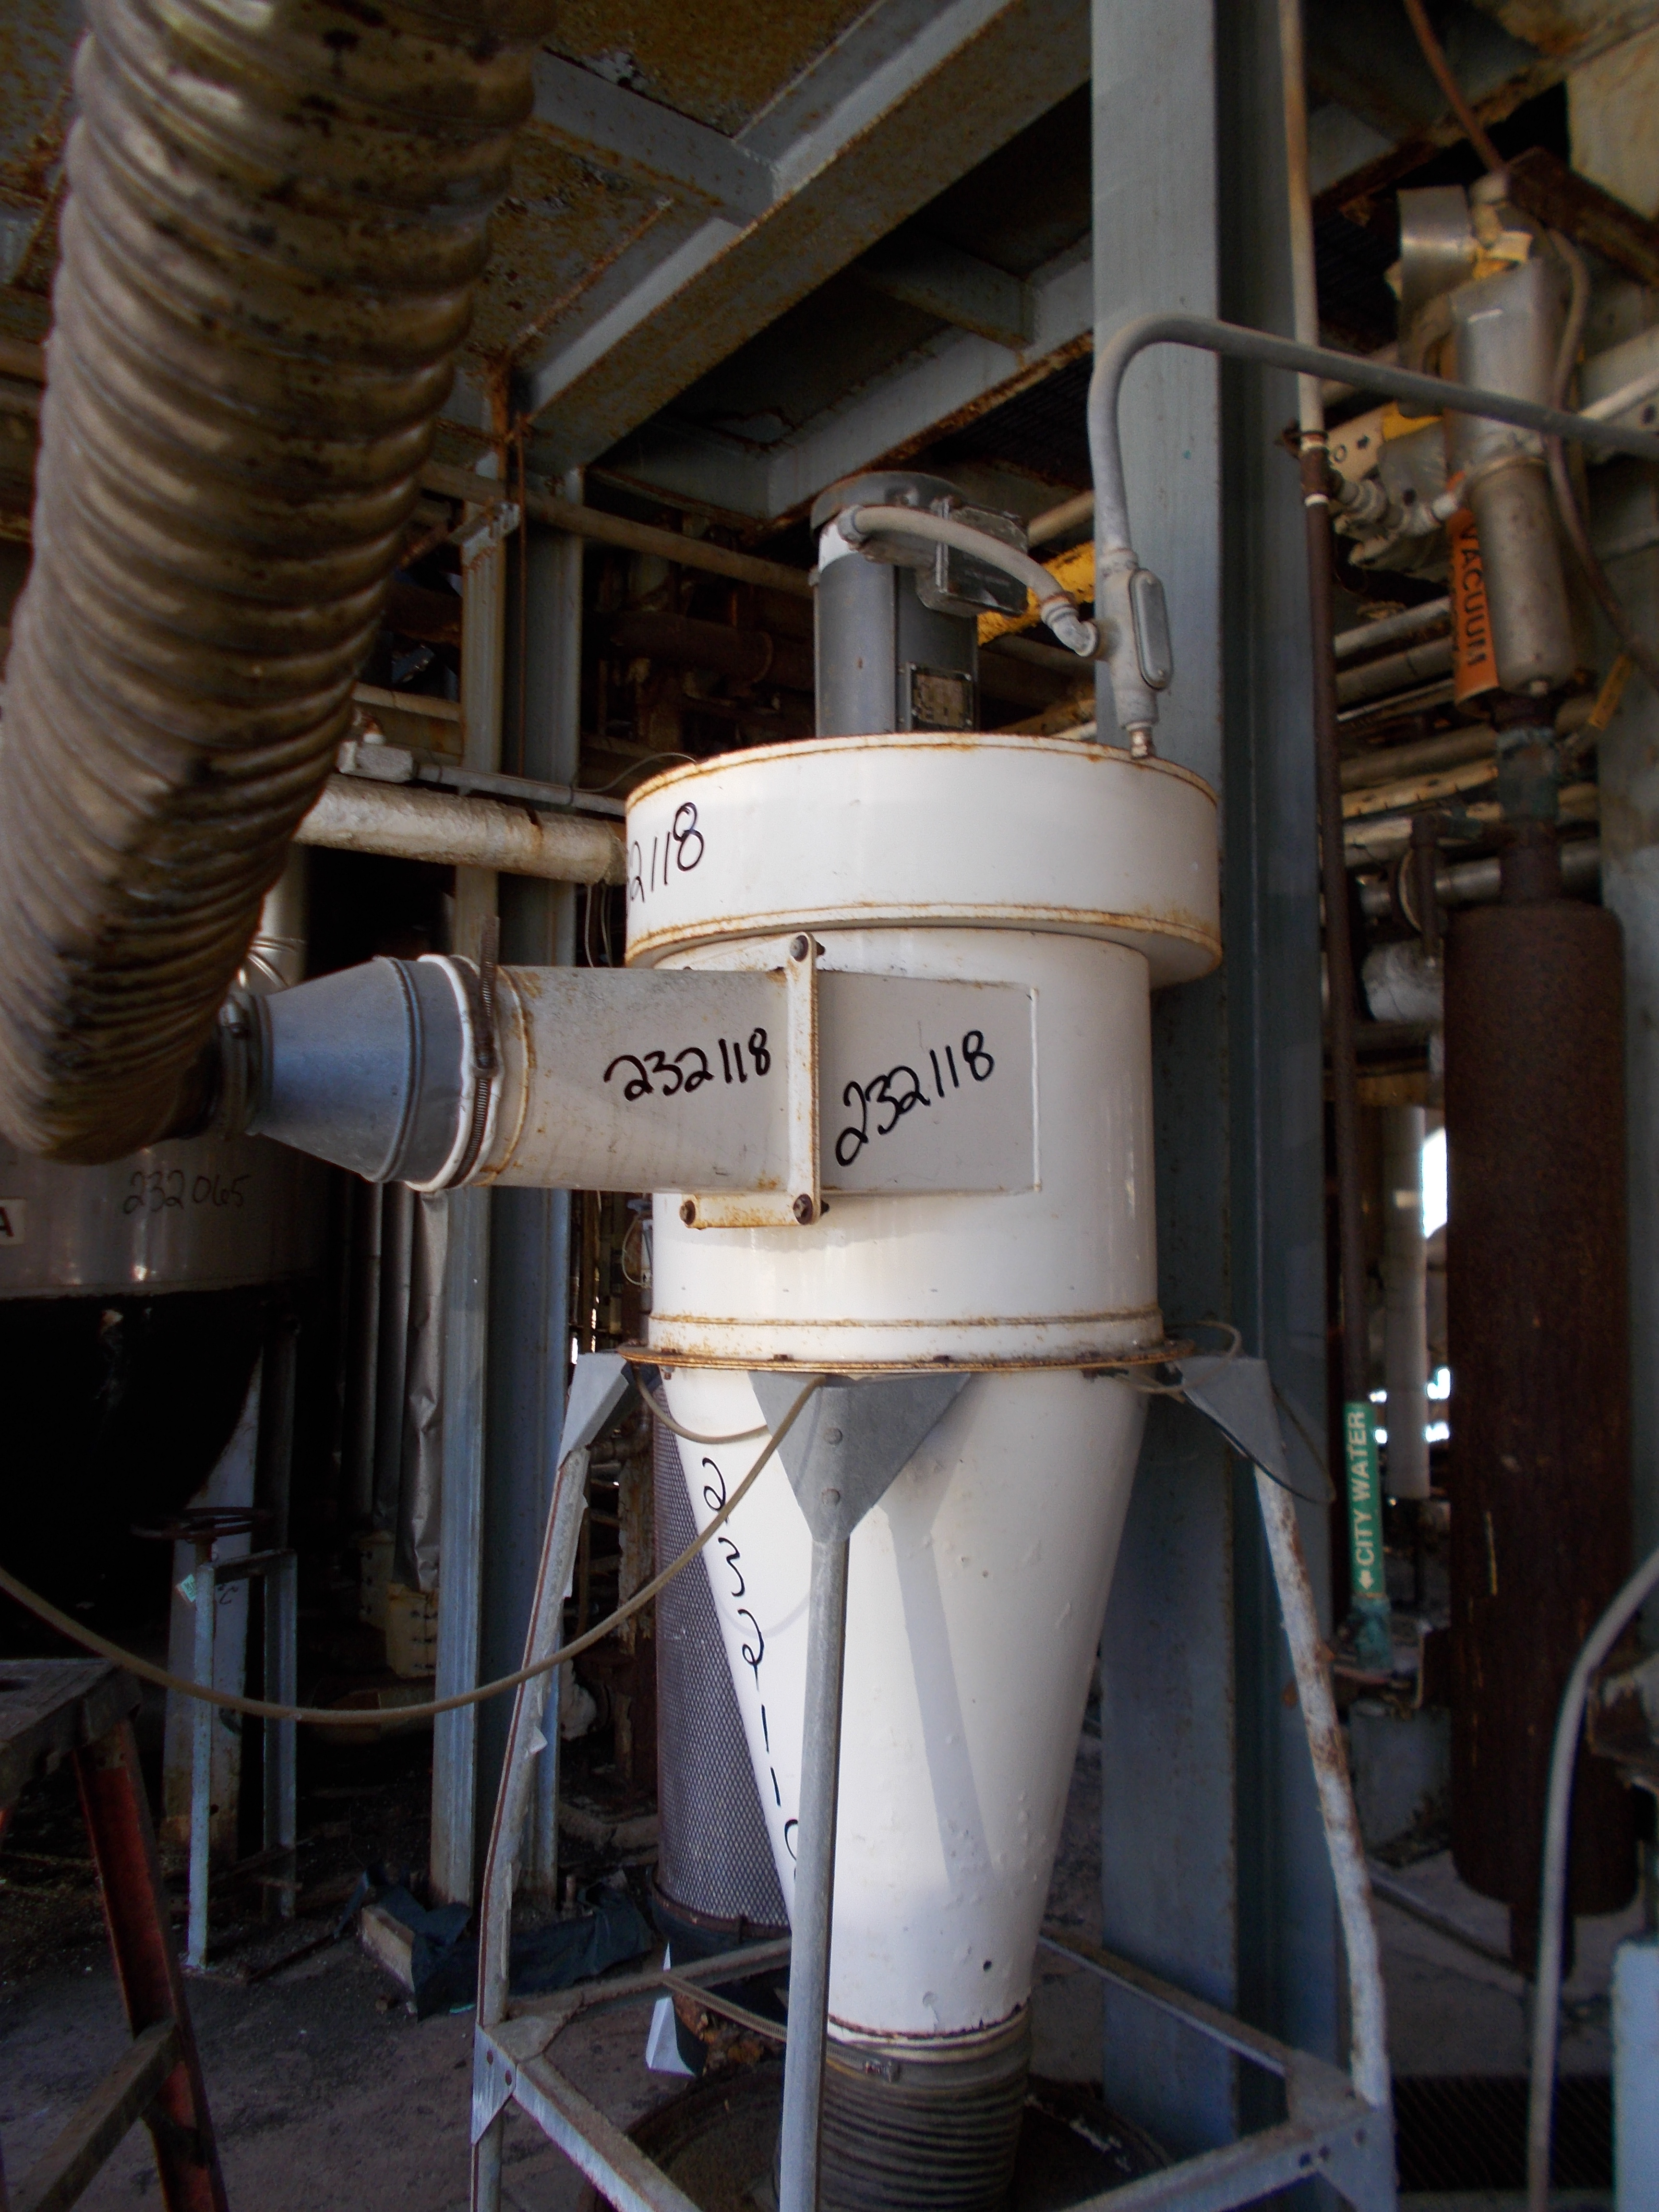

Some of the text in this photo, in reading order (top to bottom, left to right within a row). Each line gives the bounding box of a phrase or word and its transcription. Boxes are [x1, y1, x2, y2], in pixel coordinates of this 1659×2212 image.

[1459, 526, 1486, 665] VACUUM
[604, 1027, 772, 1102] 232118
[835, 1030, 995, 1167] 232118
[122, 1169, 251, 1214] 232065
[1346, 1411, 1375, 1566] CITY WATER
